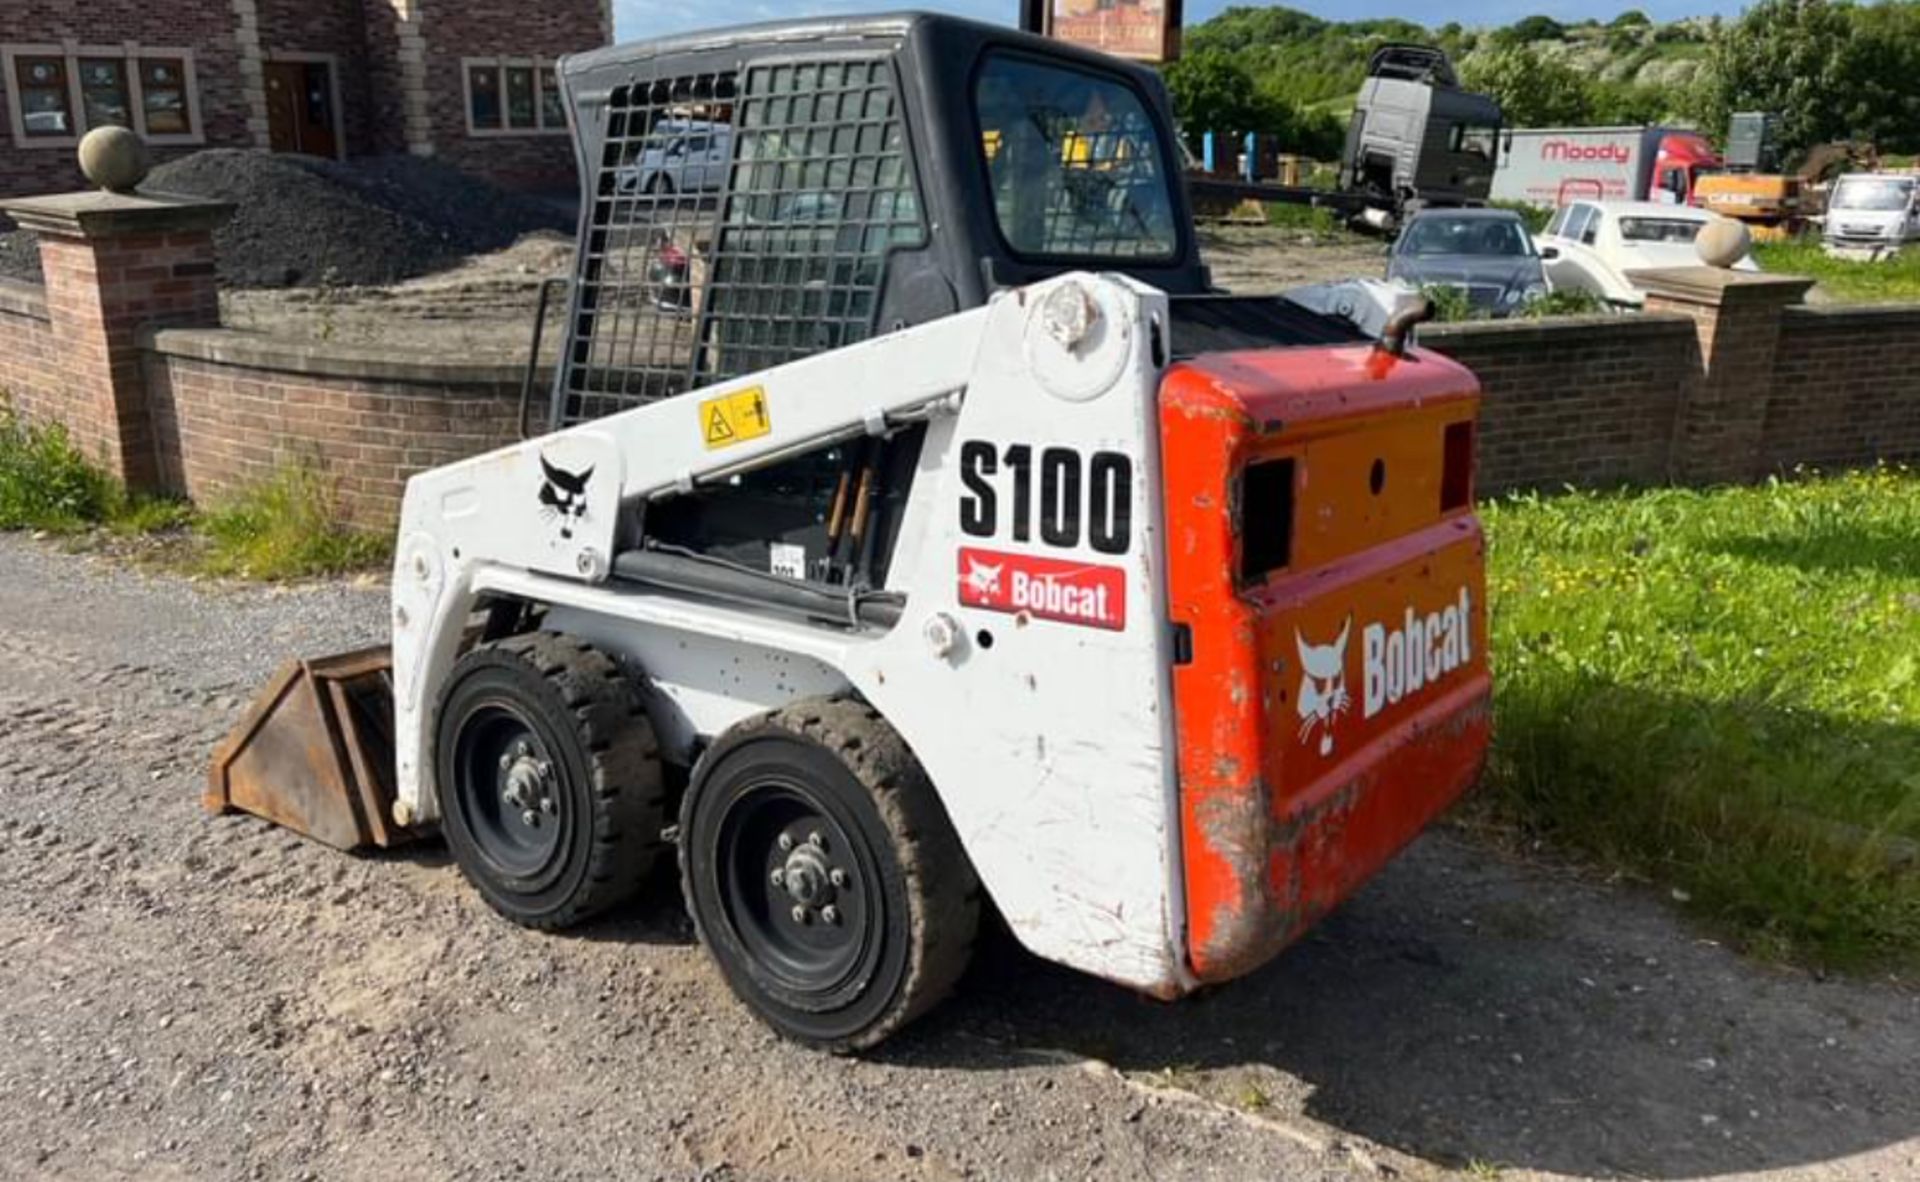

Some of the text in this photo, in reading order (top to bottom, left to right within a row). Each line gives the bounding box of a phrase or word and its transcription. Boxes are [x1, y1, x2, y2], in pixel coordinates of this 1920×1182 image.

[1541, 140, 1630, 163] Moody
[959, 439, 1133, 555] S100
[1011, 570, 1109, 620] Bobcat
[1362, 585, 1470, 719] Bobcat
